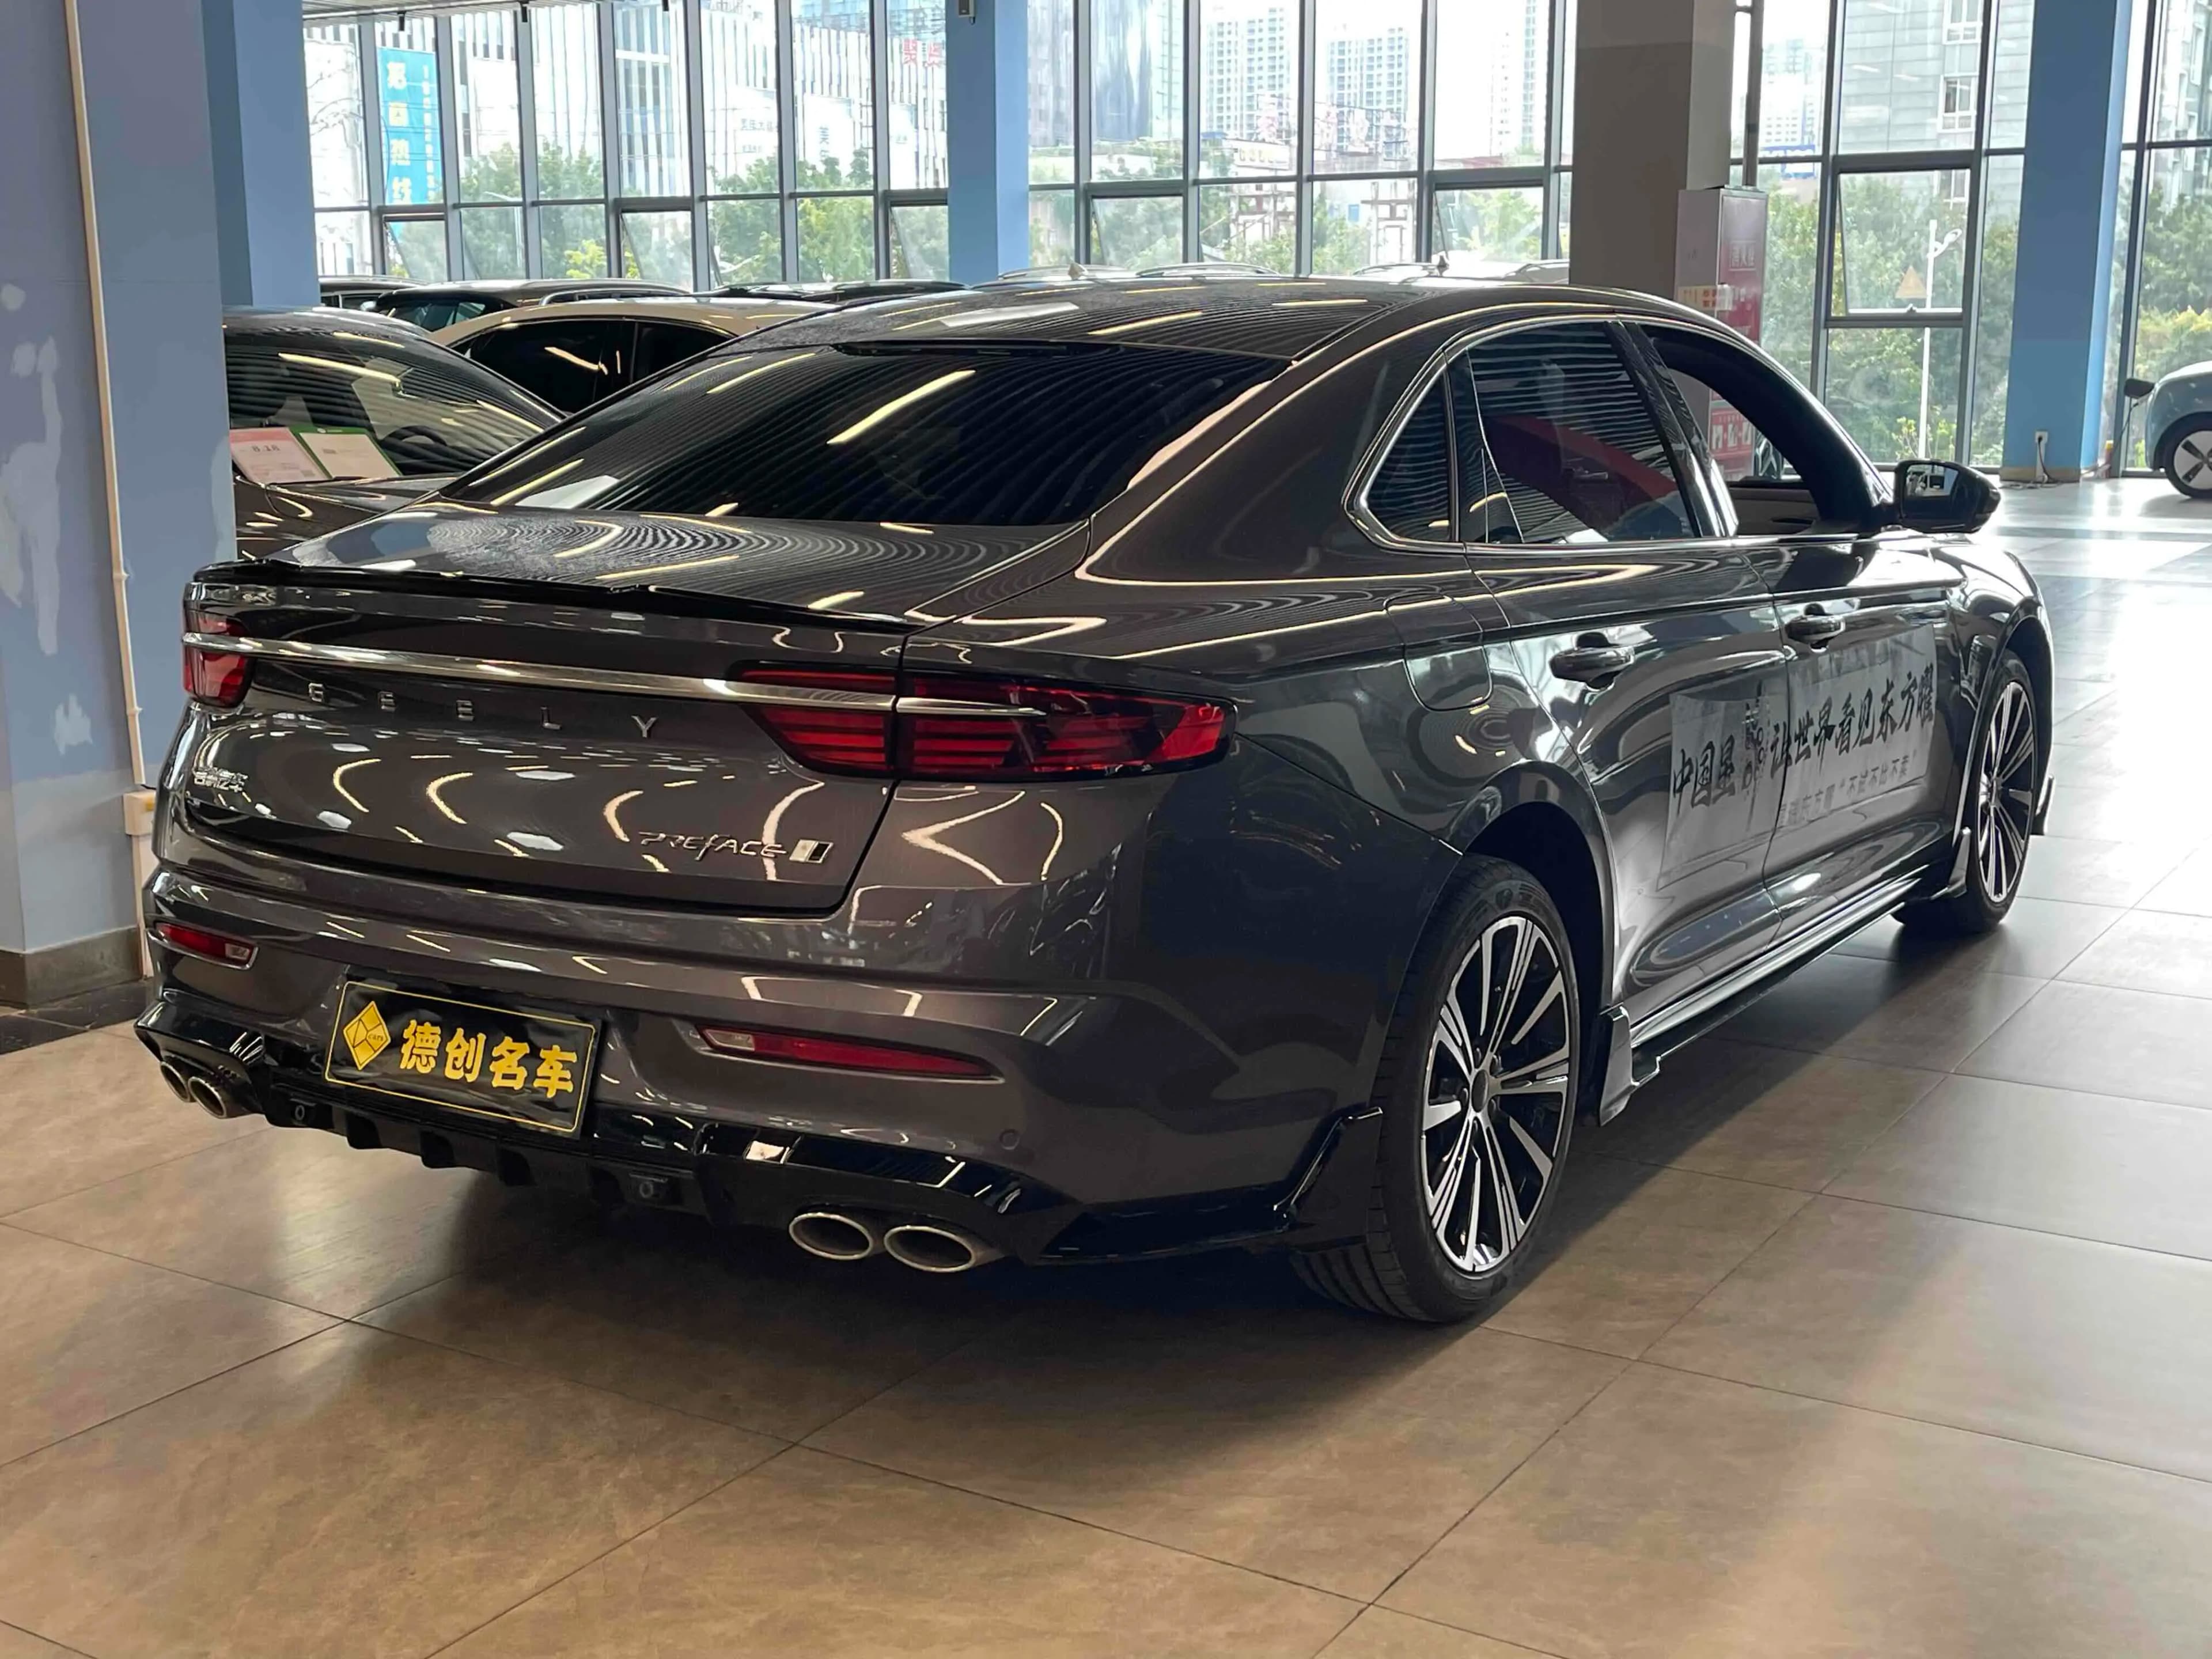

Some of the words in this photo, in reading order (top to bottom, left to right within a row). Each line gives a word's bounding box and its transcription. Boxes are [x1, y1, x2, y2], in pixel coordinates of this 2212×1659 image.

[309, 683, 657, 738] GEELY
[400, 1019, 578, 1099] 德创名车
